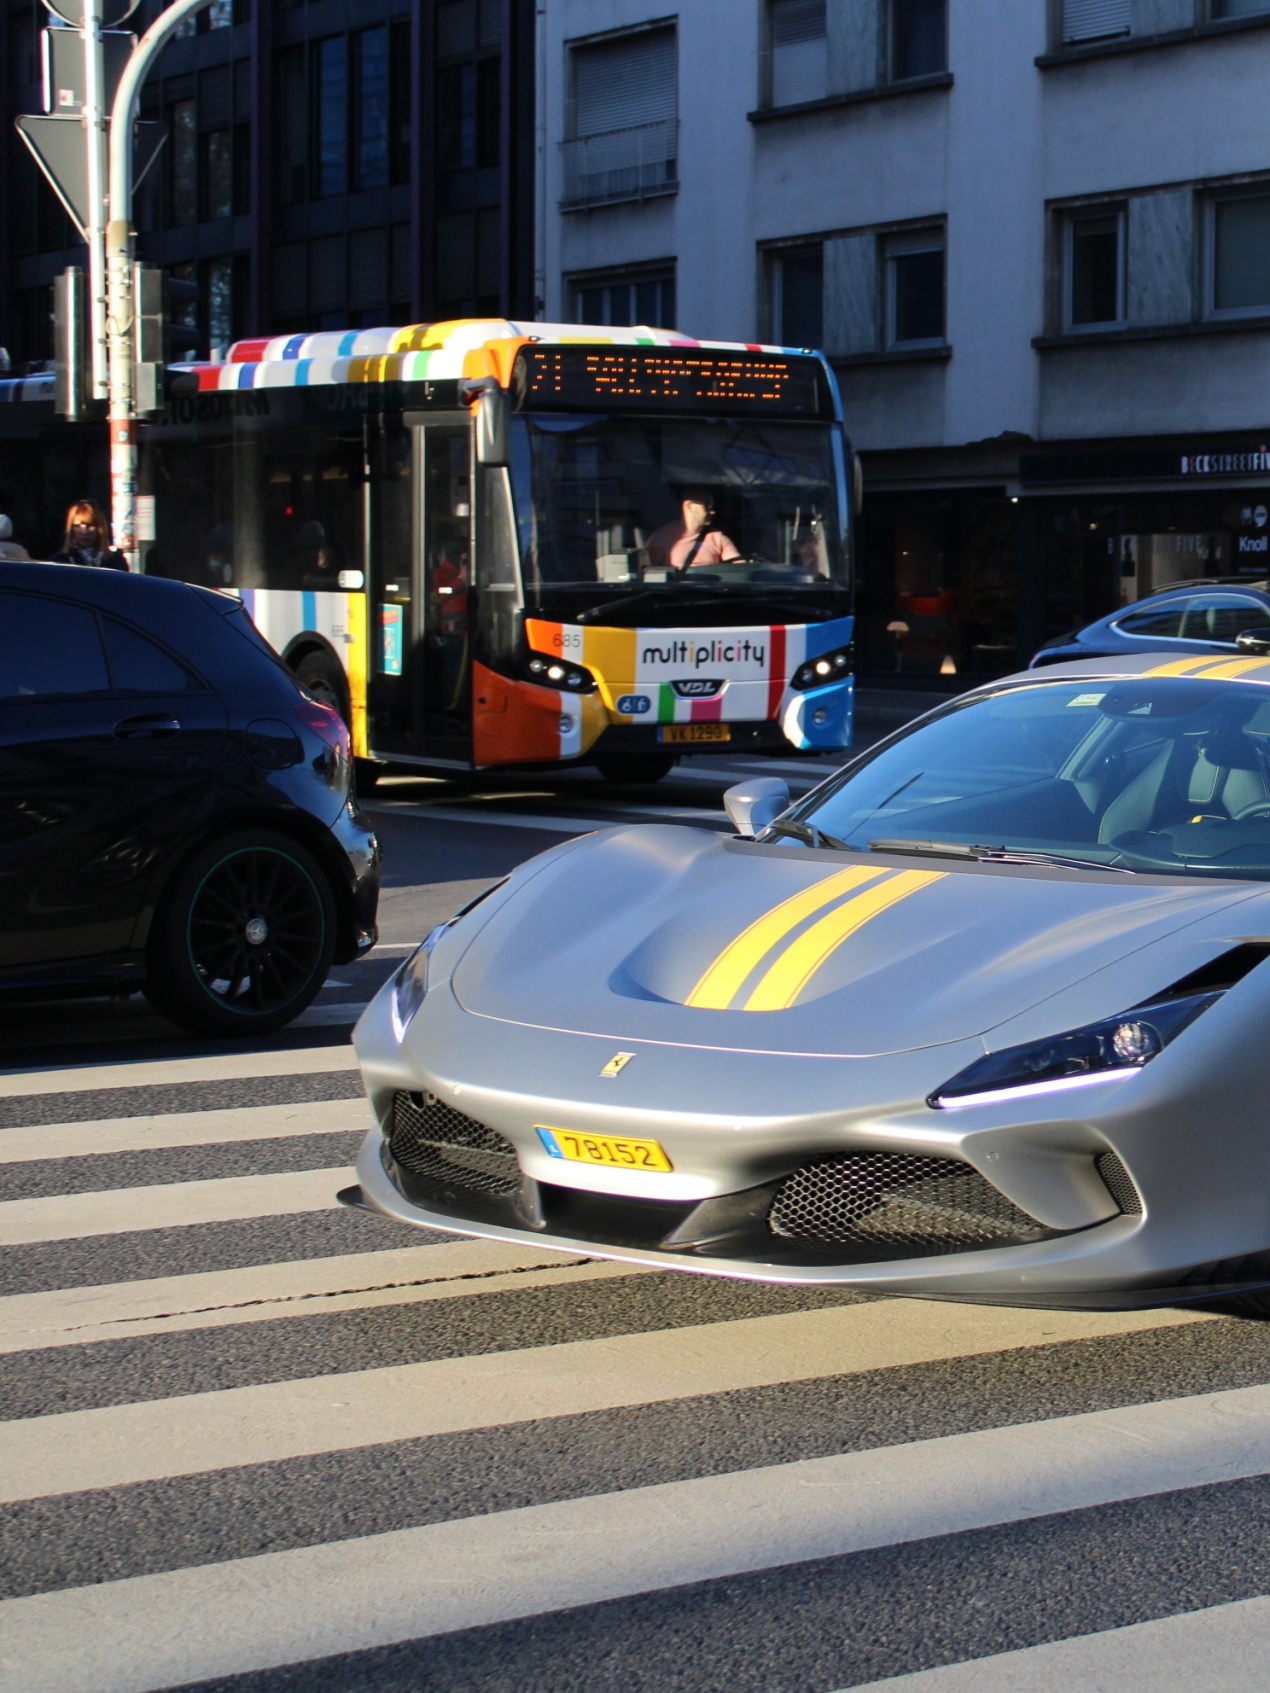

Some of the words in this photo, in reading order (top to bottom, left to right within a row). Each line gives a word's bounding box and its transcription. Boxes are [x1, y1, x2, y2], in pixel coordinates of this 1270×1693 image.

[1239, 536, 1268, 552] Knoll
[553, 632, 580, 648] 685
[643, 640, 764, 668] multiplicity
[678, 682, 716, 694] VDL
[690, 725, 722, 740] 1290
[564, 1136, 656, 1166] 78152
